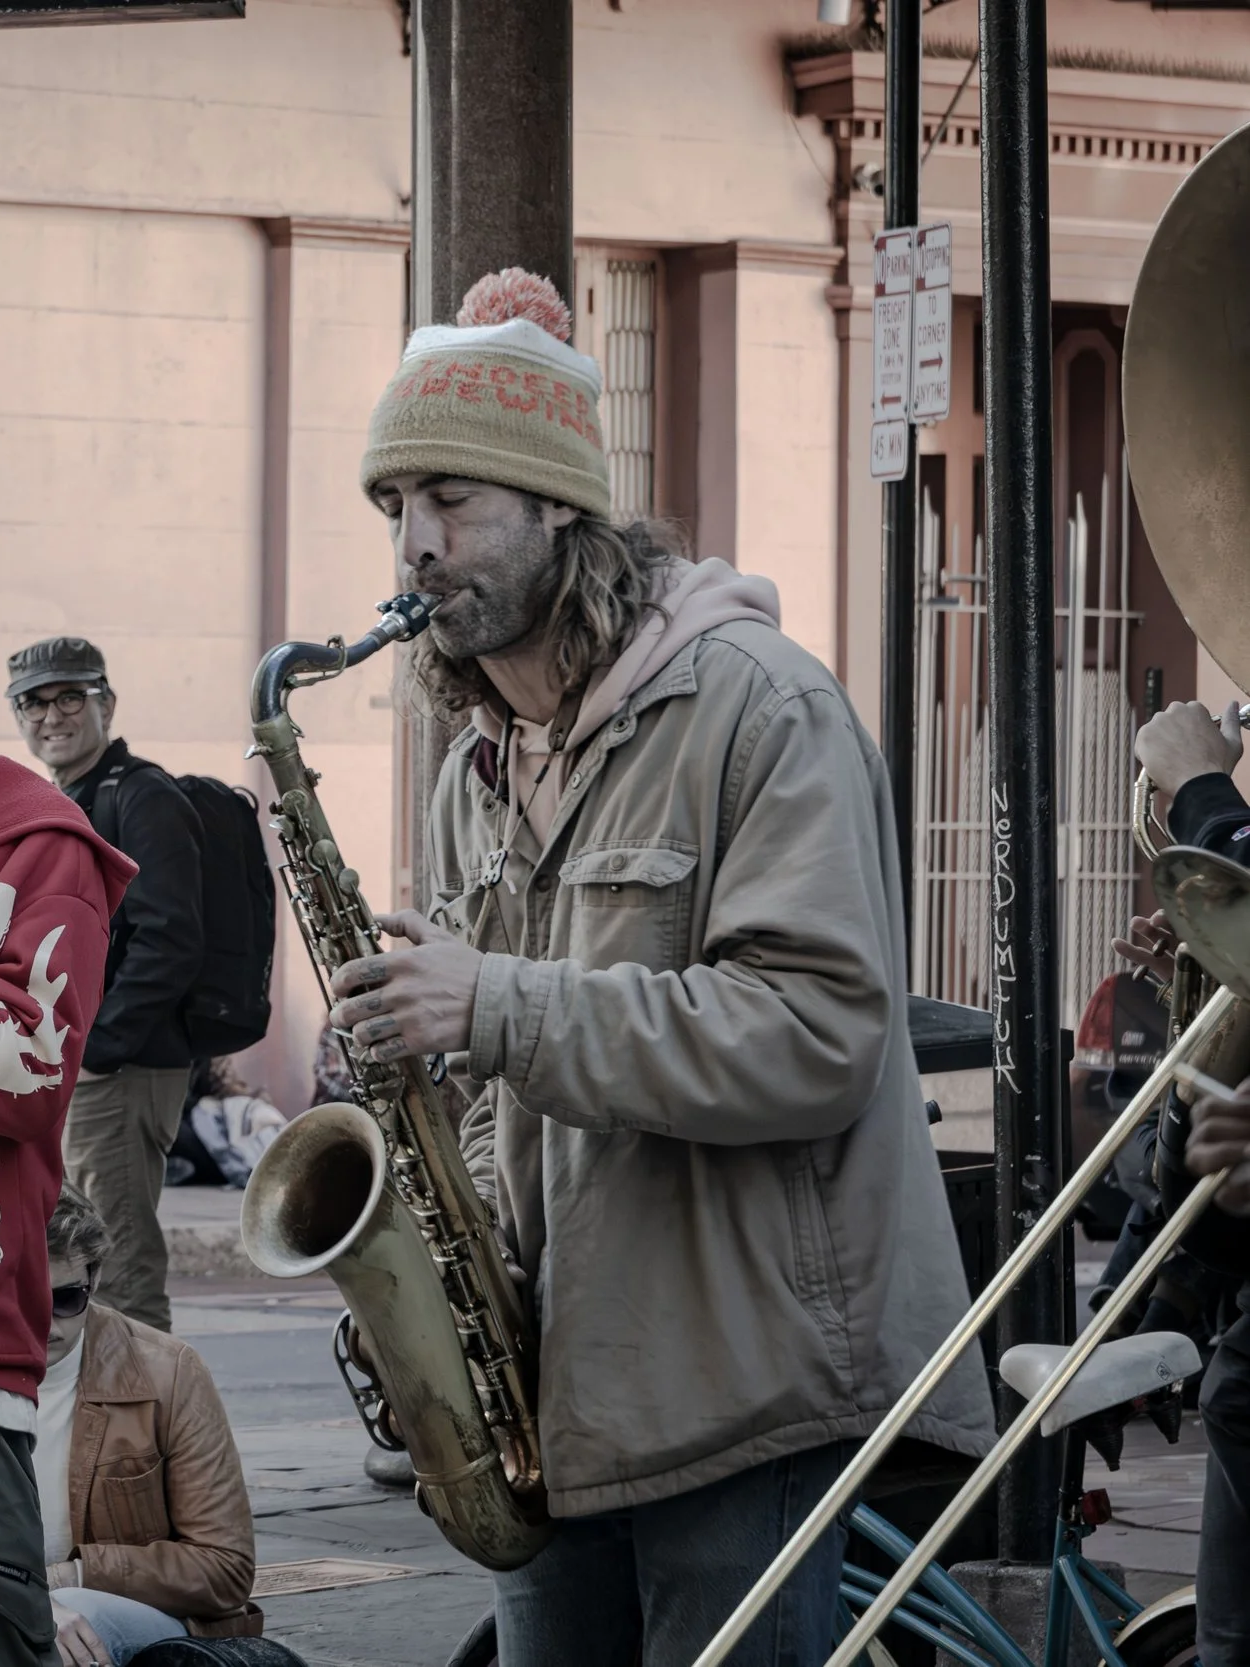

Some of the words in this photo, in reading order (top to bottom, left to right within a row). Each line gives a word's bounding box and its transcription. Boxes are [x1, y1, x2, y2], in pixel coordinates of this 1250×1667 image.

[874, 249, 886, 285] NO
[886, 252, 910, 278] PARKING
[926, 244, 950, 271] STOPPING
[878, 300, 906, 325] FREIGHT
[927, 294, 937, 315] TO
[882, 327, 901, 350] ZONE
[917, 321, 947, 346] CORNER
[915, 380, 947, 404] ANYTIME
[874, 434, 884, 461] 45
[888, 432, 902, 459] MIN
